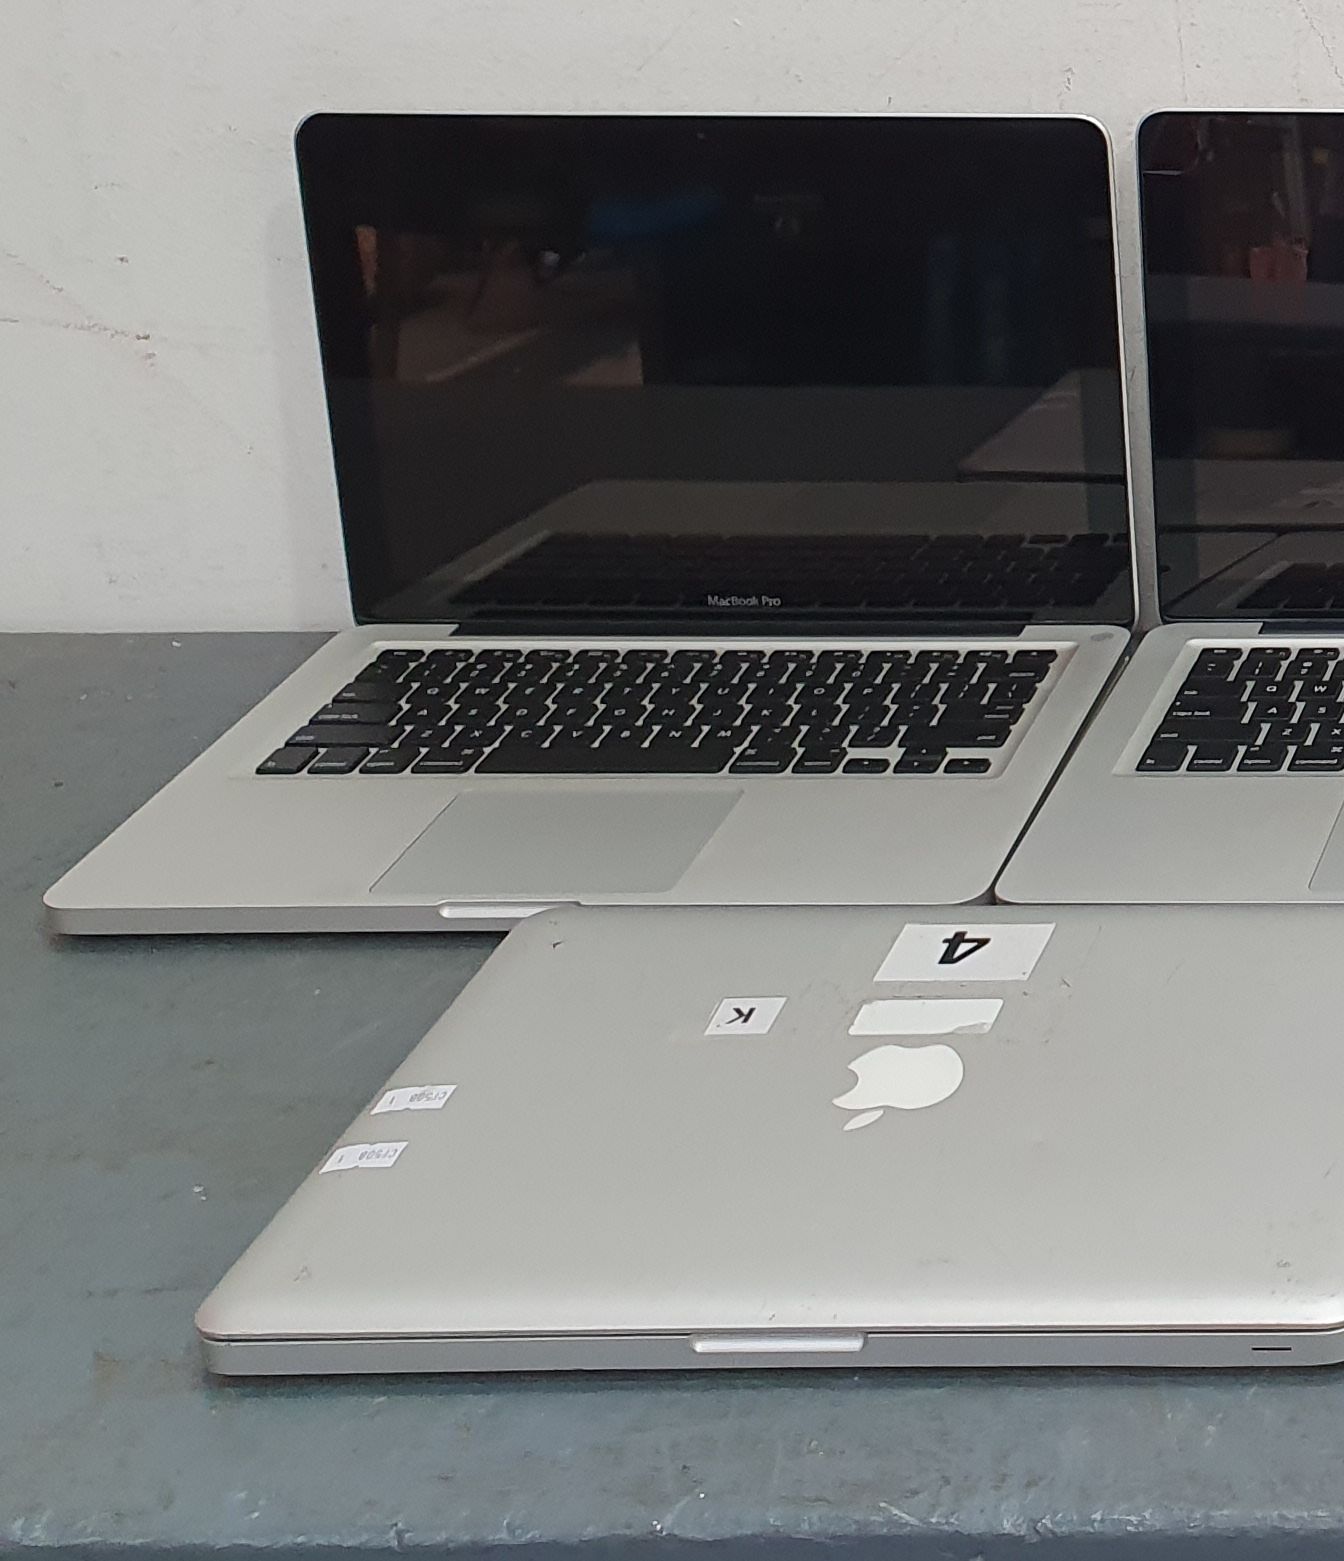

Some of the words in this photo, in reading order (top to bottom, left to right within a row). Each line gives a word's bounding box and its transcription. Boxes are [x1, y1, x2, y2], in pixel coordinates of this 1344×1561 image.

[707, 594, 760, 607] MacBook
[761, 595, 782, 607] Pro
[938, 931, 991, 964] 4
[725, 1007, 756, 1024] K
